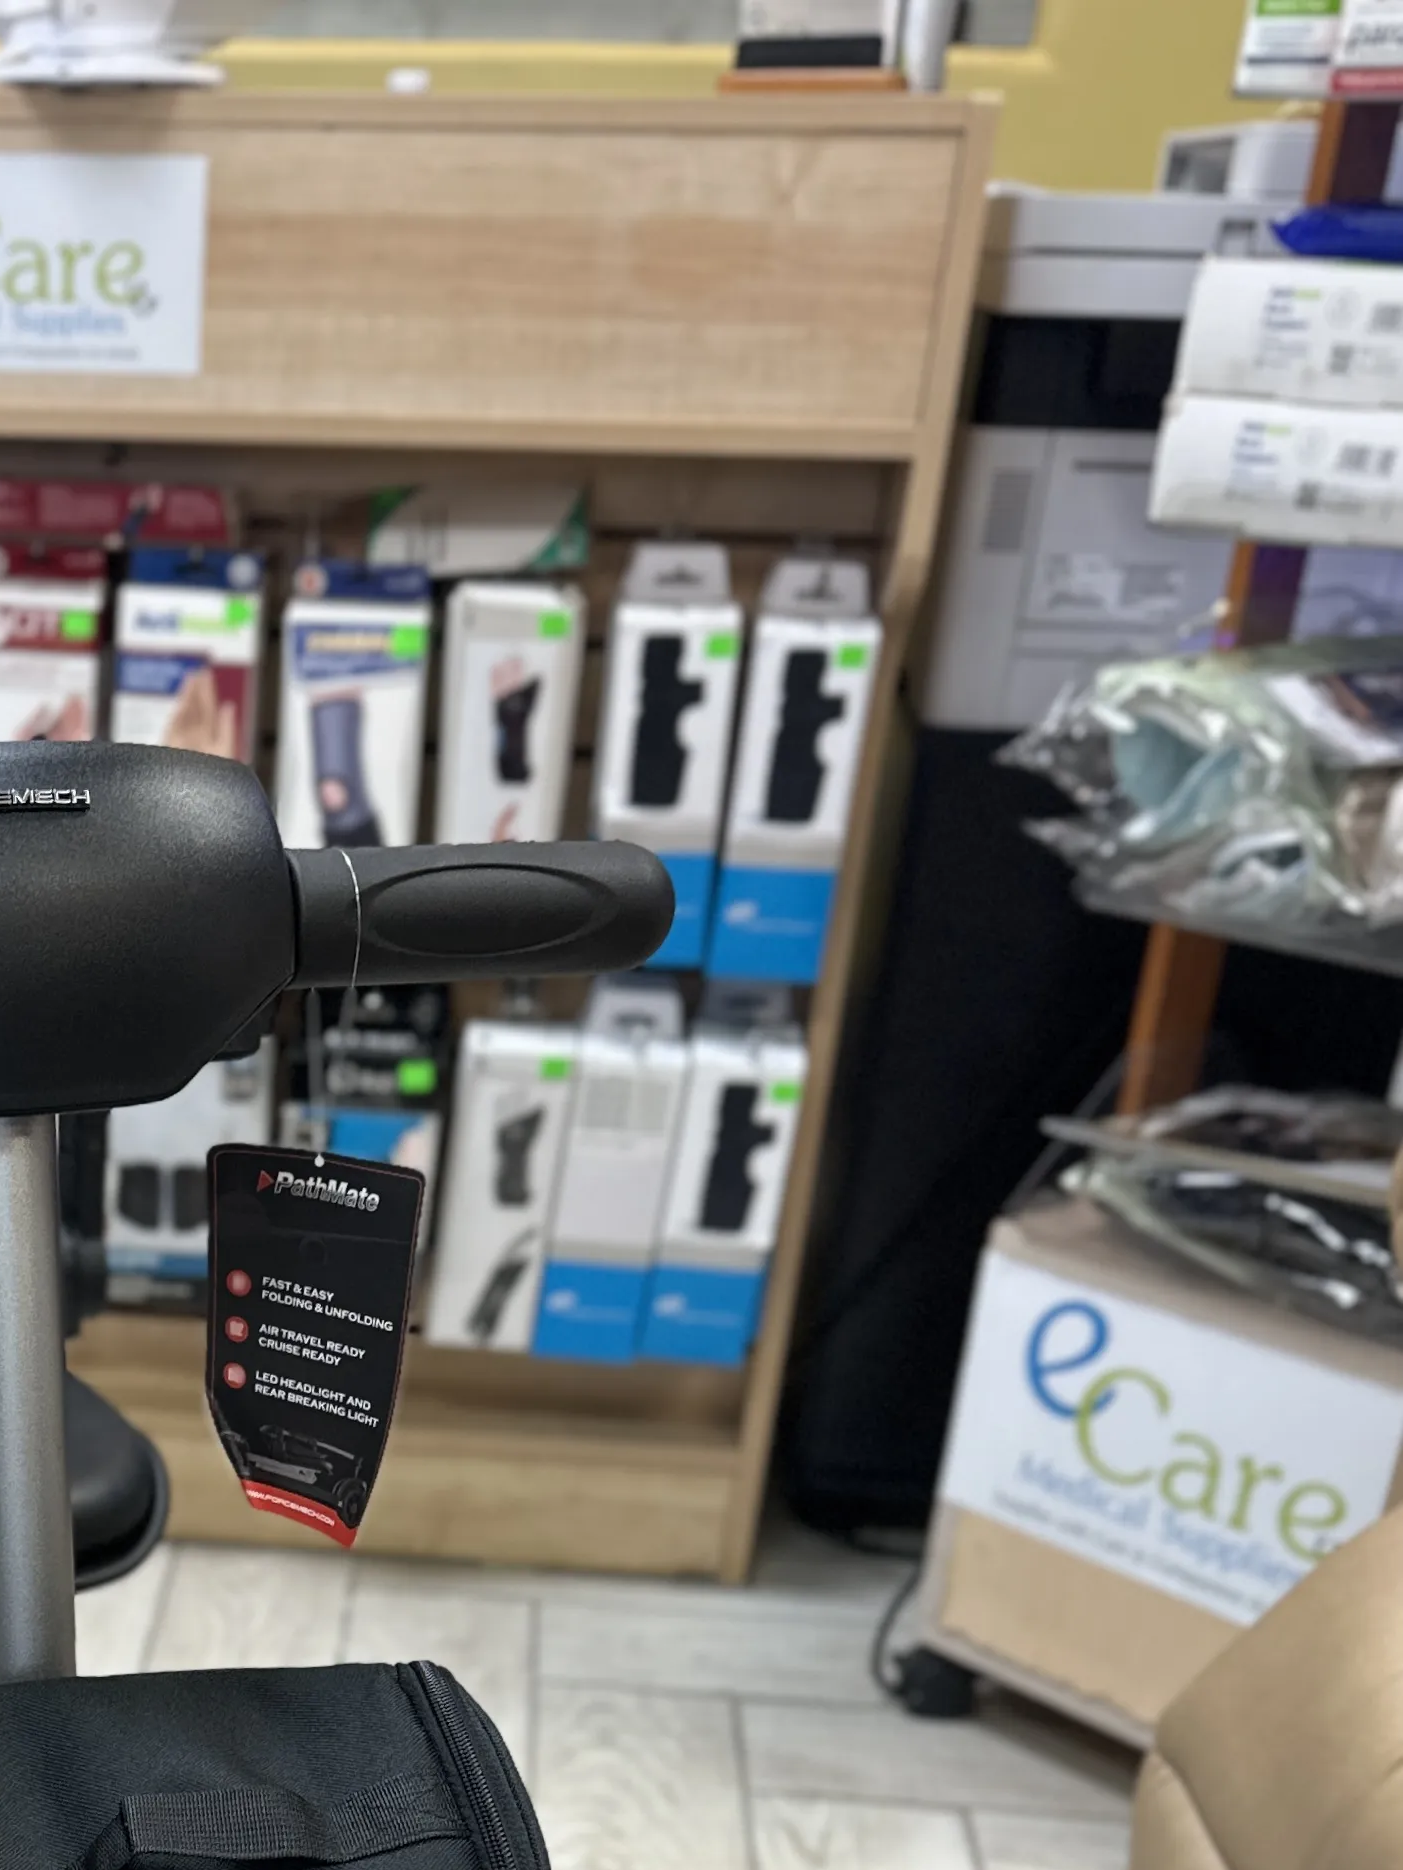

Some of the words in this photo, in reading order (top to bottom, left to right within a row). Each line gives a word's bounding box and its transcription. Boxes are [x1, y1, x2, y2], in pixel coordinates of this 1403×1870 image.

[274, 1171, 380, 1212] PathMate
[262, 1276, 292, 1291] FAST
[293, 1284, 302, 1294] &
[303, 1286, 334, 1302] EASY
[261, 1289, 313, 1311] FOLDING
[314, 1303, 323, 1314] &
[324, 1305, 394, 1332] UNFOLDING
[258, 1323, 279, 1337] AIR
[280, 1328, 325, 1349] TRAVEL
[326, 1340, 366, 1359] READY
[258, 1336, 301, 1356] CRUISE
[302, 1348, 341, 1366] READY
[254, 1383, 286, 1400] REAR
[287, 1392, 346, 1417] BREAKING
[347, 1408, 379, 1428] LIGHT
[255, 1370, 278, 1385] LED
[279, 1376, 346, 1403] HEADLIGHT
[346, 1395, 371, 1411] AND
